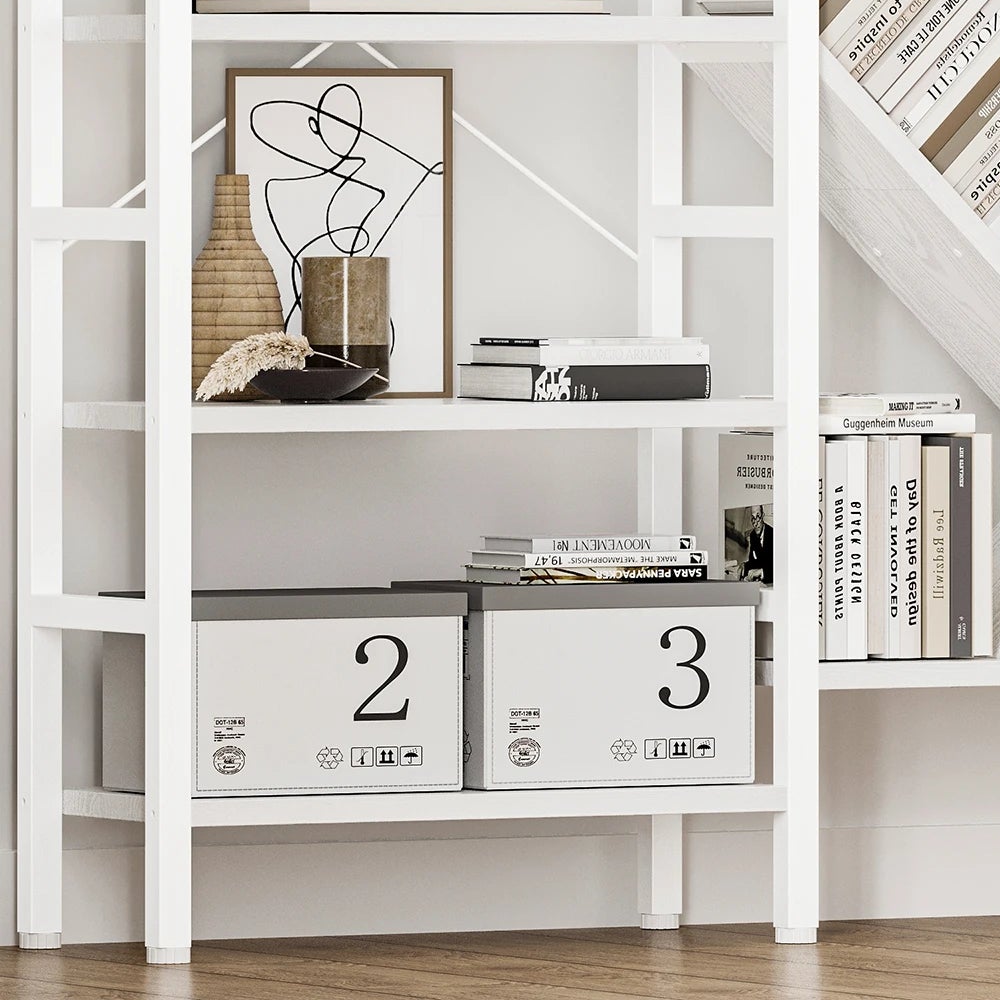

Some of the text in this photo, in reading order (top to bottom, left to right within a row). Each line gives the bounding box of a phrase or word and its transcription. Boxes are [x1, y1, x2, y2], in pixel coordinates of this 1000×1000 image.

[843, 417, 934, 431] Guggenheim Museum
[572, 538, 651, 551] MOOVEMENT
[535, 554, 563, 566] 19,47
[638, 555, 655, 563] THE
[656, 555, 677, 563] MAKE
[595, 567, 702, 581] SARA PENNYPACKER
[658, 625, 710, 710] 3
[353, 635, 410, 721] 2
